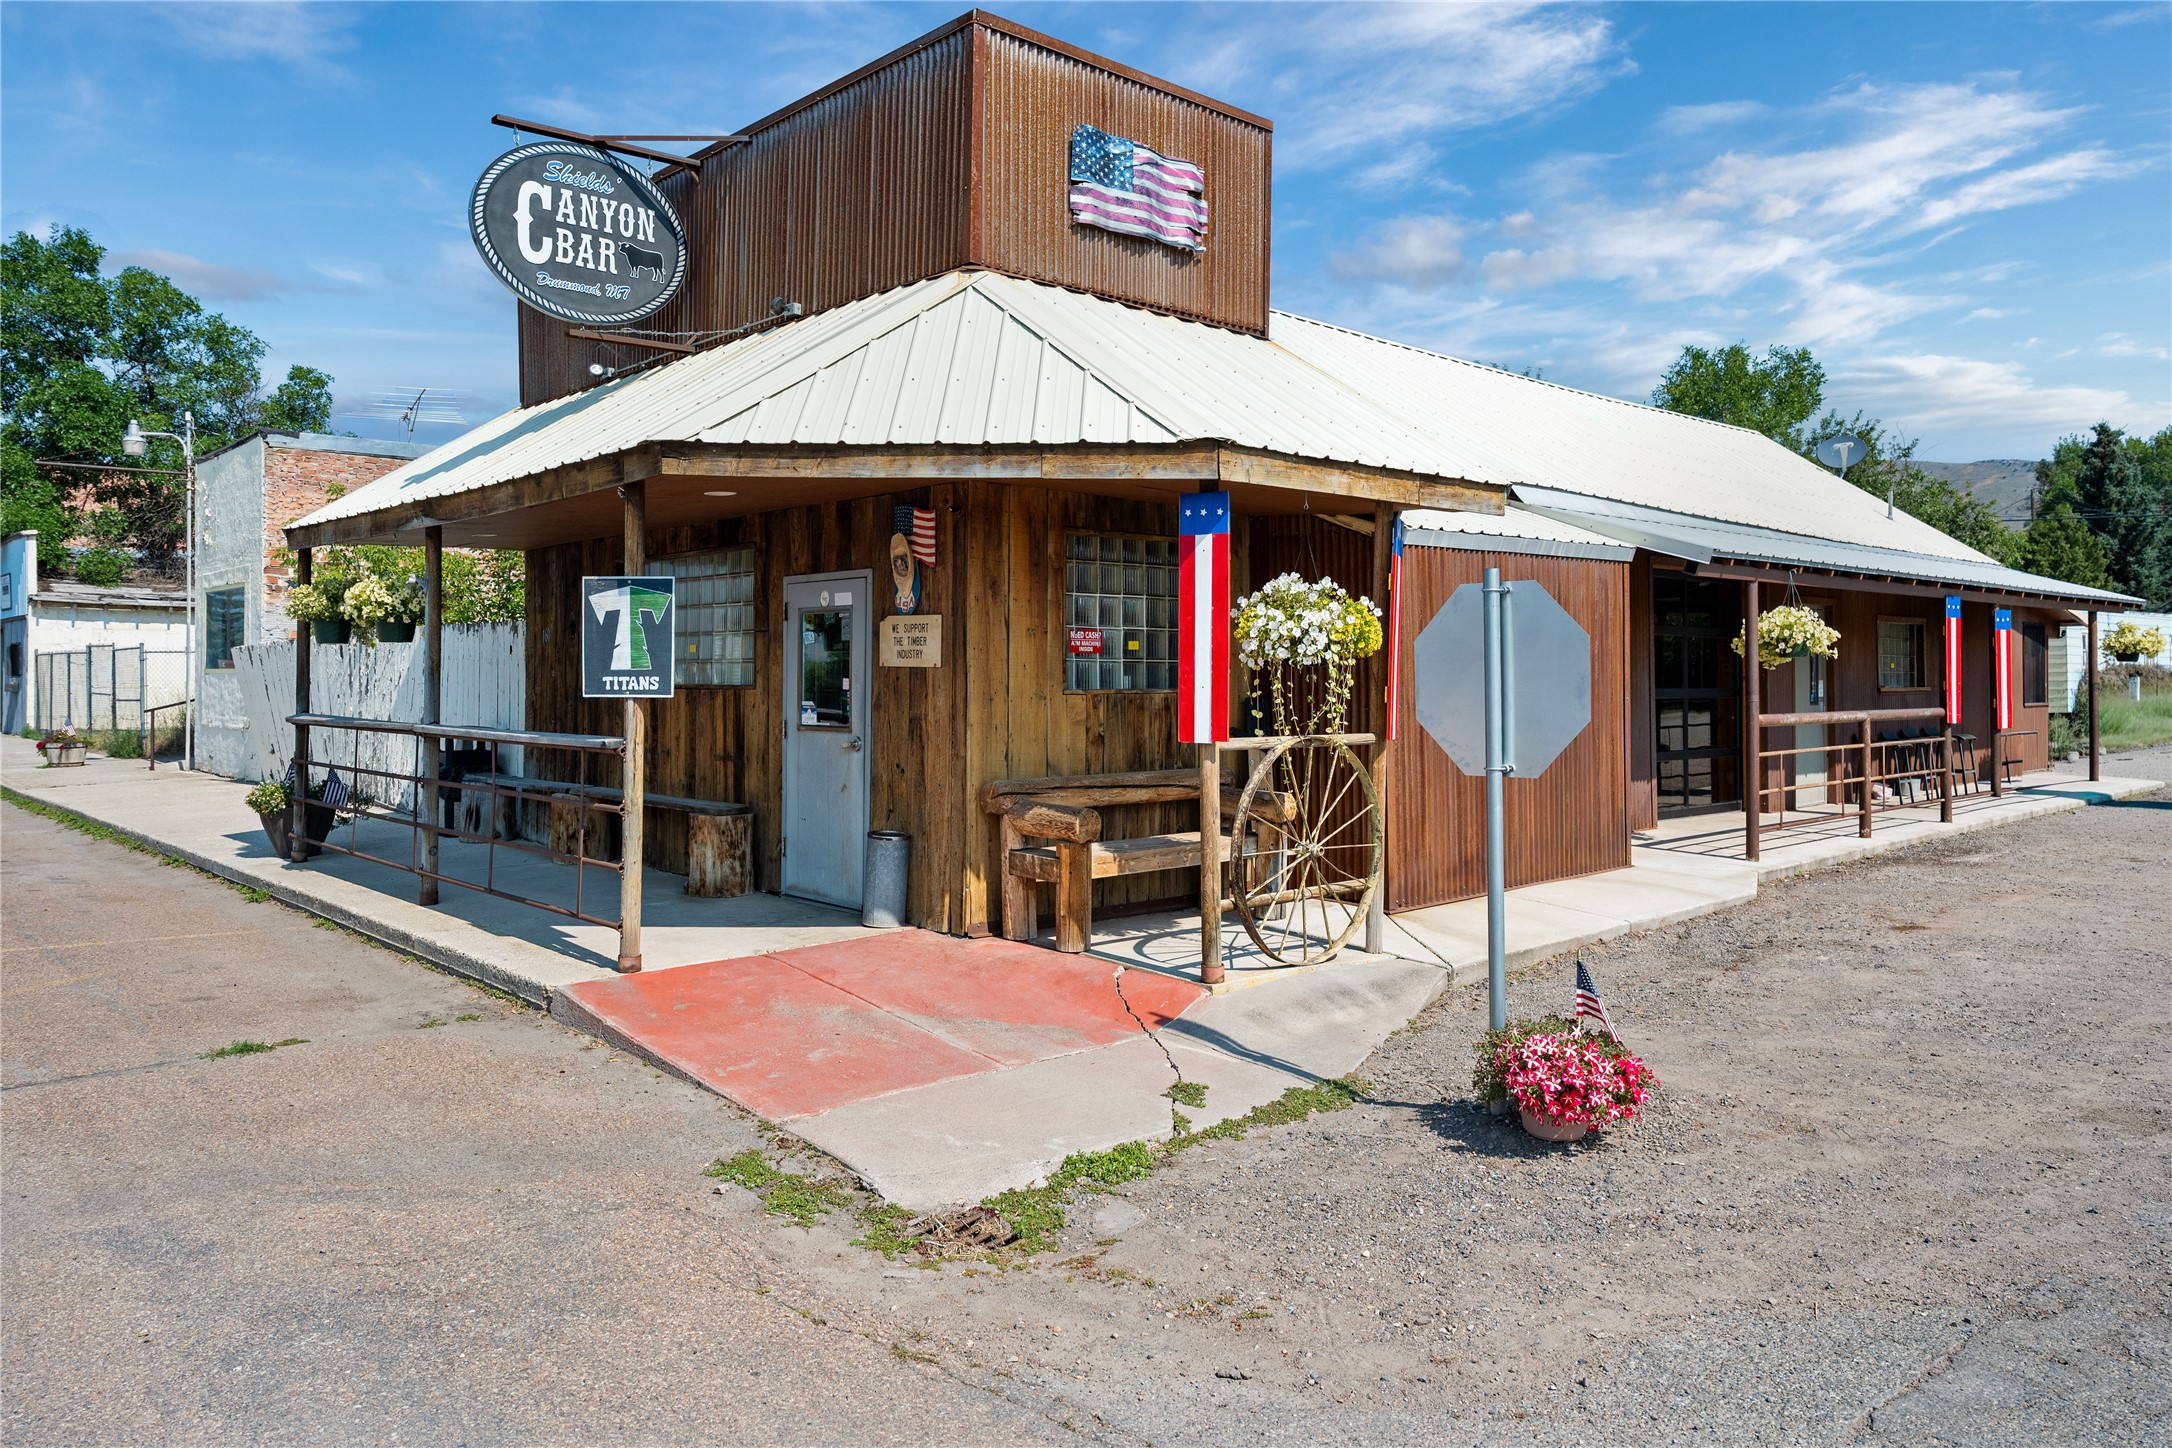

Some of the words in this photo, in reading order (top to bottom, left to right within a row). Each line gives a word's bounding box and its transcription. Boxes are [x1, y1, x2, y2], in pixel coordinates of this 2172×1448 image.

[543, 160, 622, 194] Shields'
[513, 180, 656, 265] CANYON
[555, 227, 618, 275] BAR
[536, 271, 601, 296] Drummond,
[605, 283, 631, 300] MT
[895, 596, 914, 611] USA
[892, 623, 900, 633] WE
[904, 623, 929, 633] SUPPORT
[893, 636, 903, 646] THE
[907, 636, 927, 646] TIMBER
[896, 649, 923, 659] INDUSTRY
[602, 676, 660, 691] TITANS
